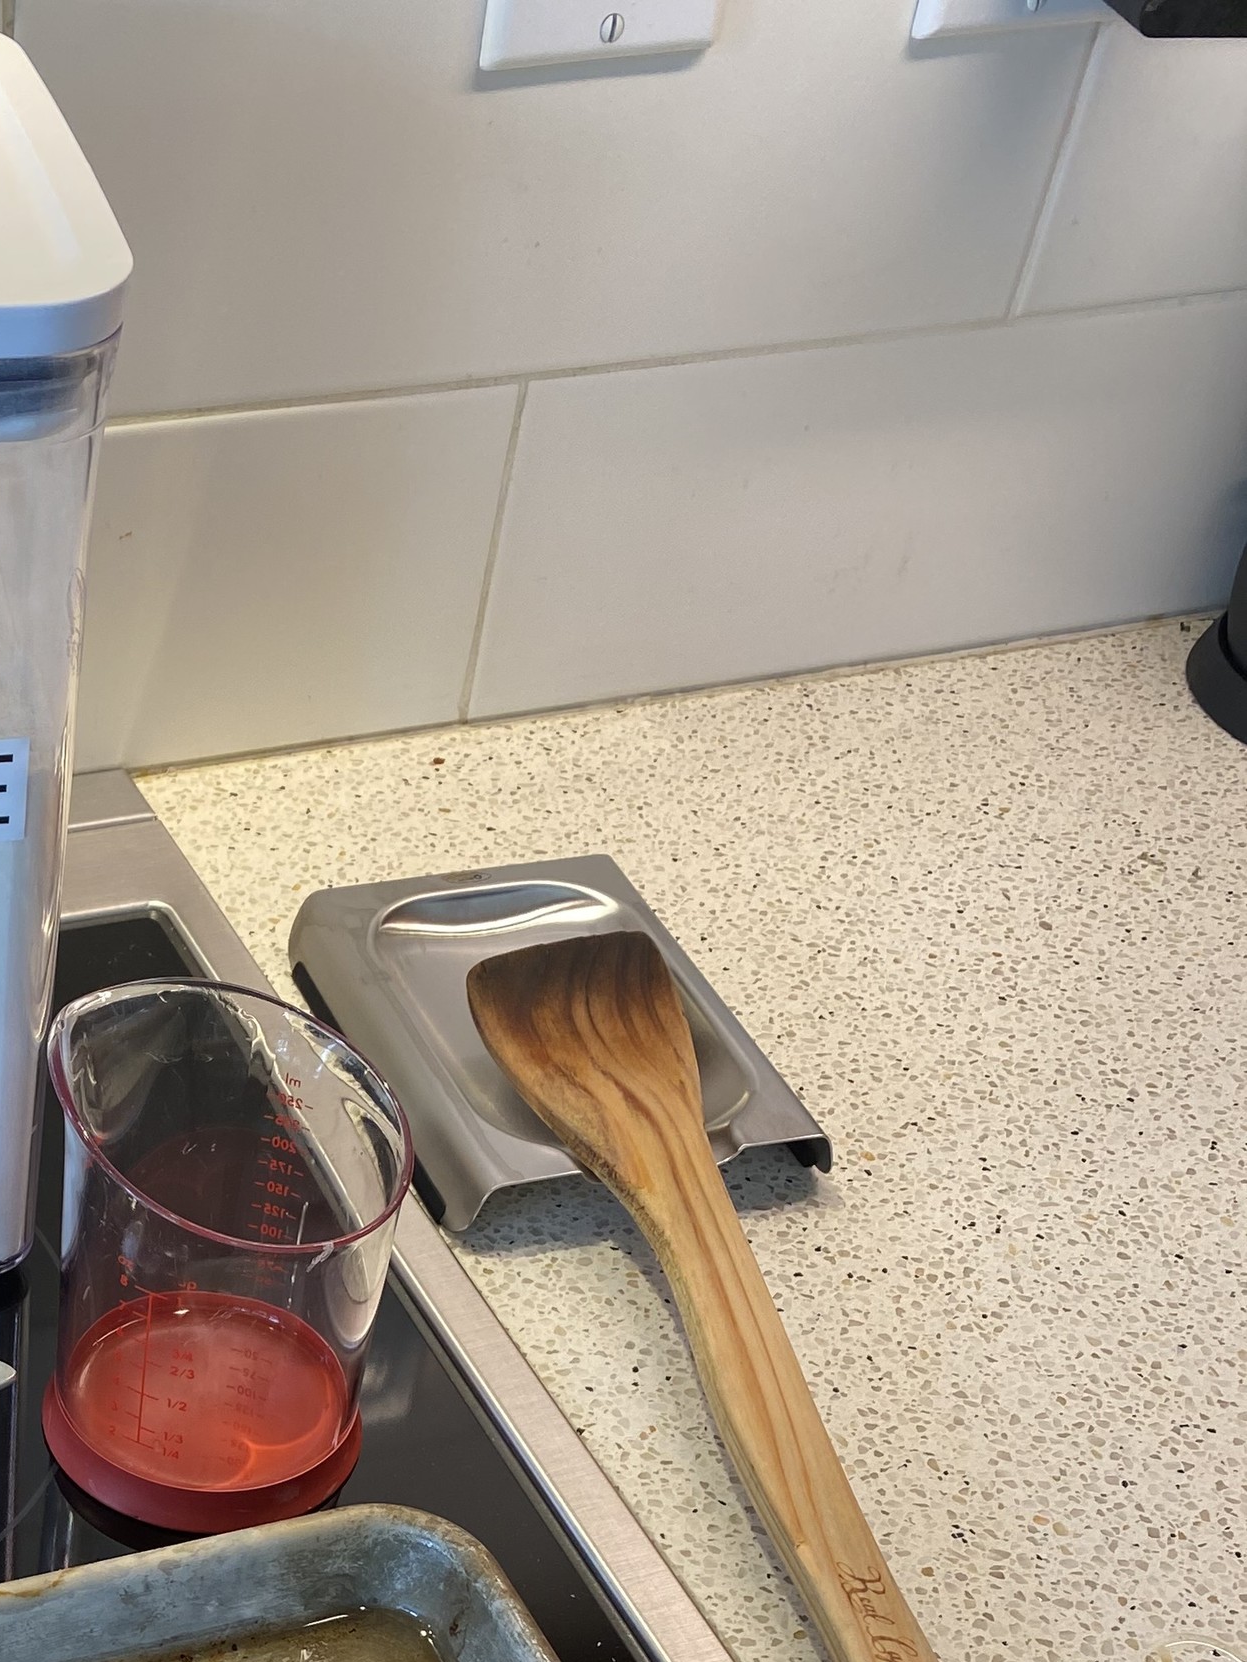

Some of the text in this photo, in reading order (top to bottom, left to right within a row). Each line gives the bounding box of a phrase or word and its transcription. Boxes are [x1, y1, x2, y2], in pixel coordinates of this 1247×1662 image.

[170, 1365, 195, 1380] 2/3
[167, 1397, 187, 1412] 1/2
[164, 1431, 184, 1445] 1/3
[162, 1446, 179, 1460] 1/4
